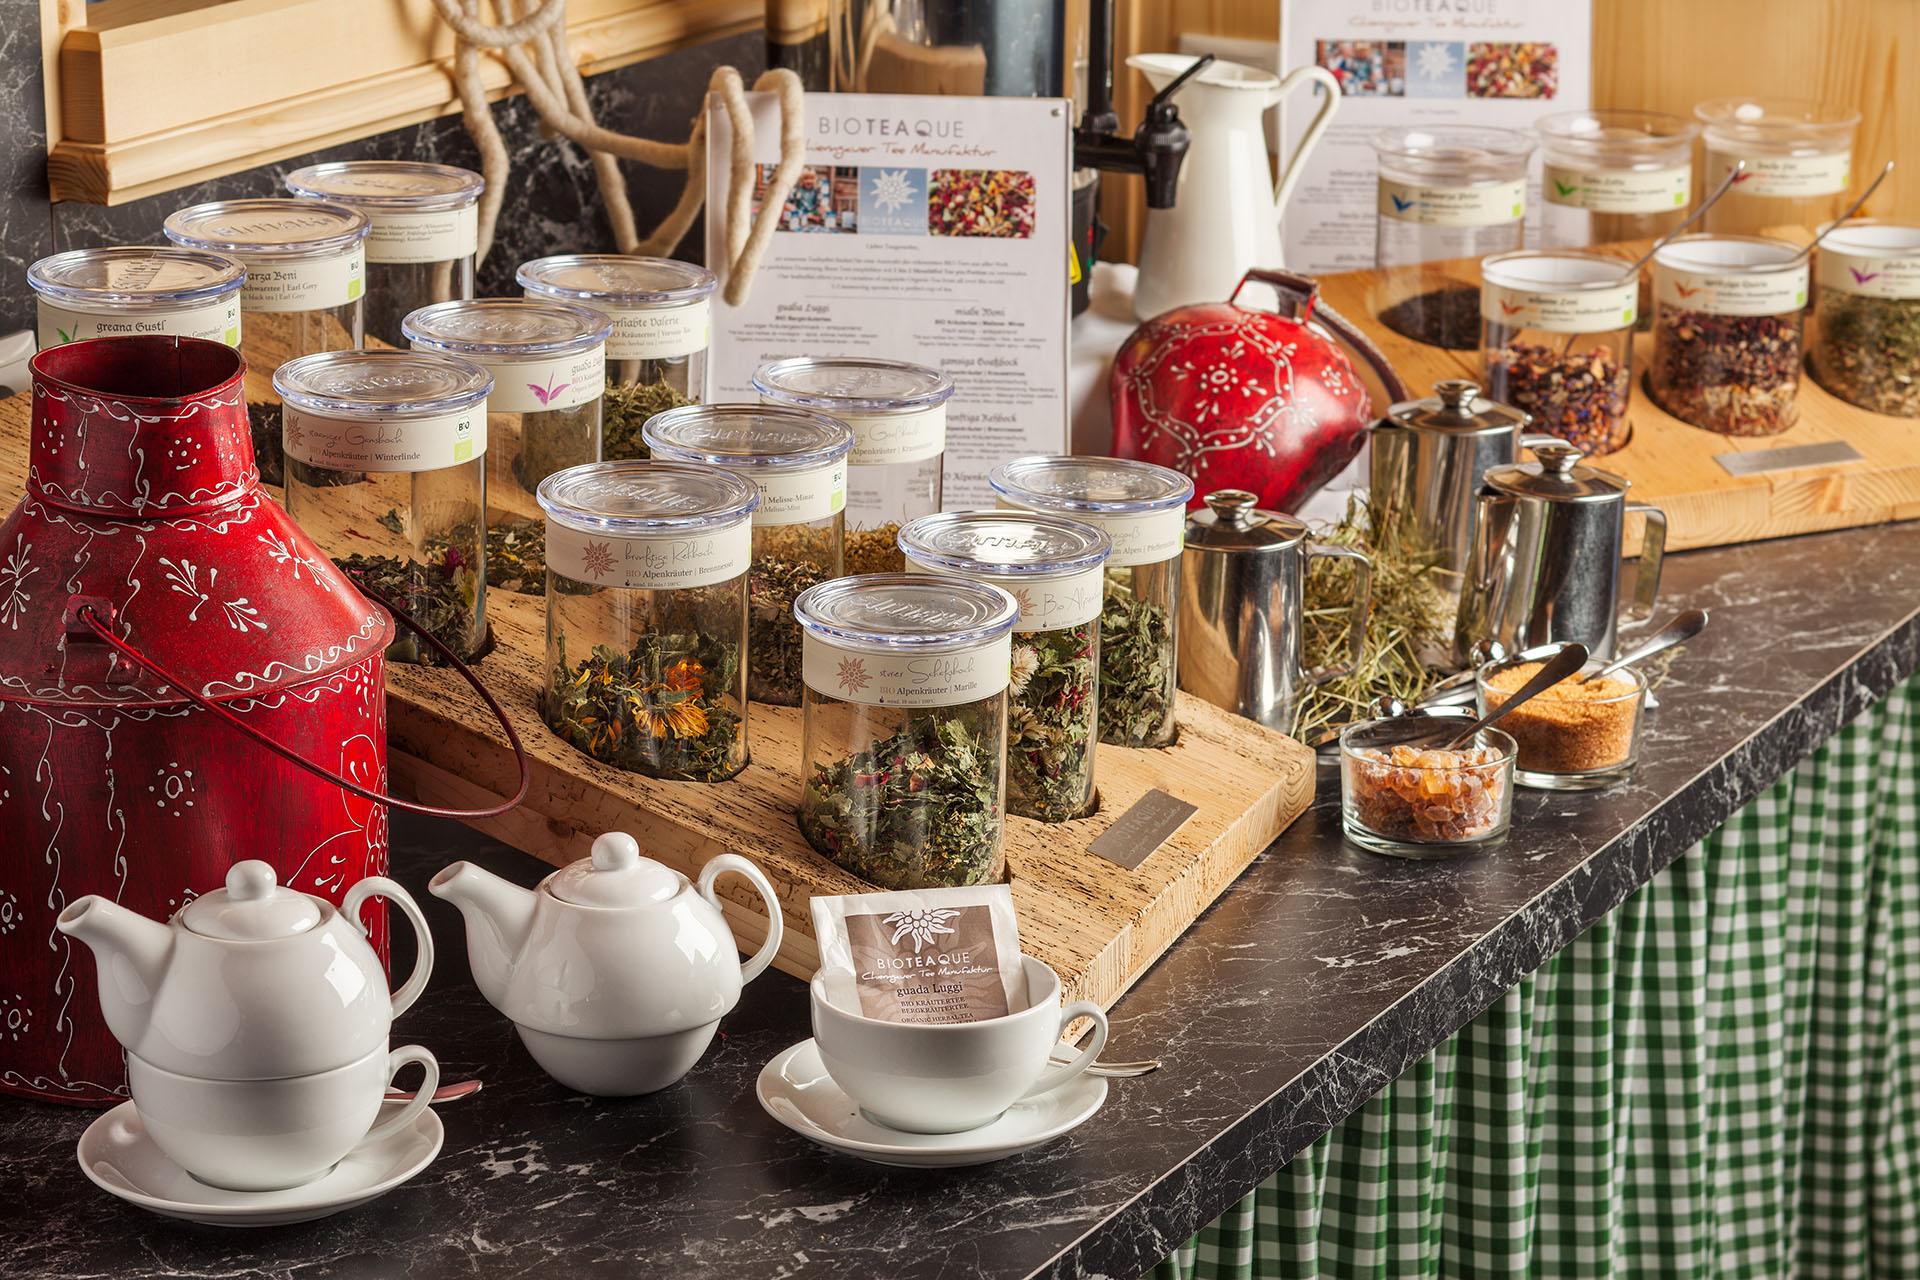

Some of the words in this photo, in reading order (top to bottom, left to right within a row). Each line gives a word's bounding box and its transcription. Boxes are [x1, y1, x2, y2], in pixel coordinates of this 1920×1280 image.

[819, 116, 964, 138] BIOTEAQUE
[882, 142, 905, 155] Tee
[910, 142, 998, 158] Manufaktur
[273, 269, 298, 281] Beni
[287, 283, 302, 292] Earl
[96, 322, 133, 334] greana
[135, 319, 167, 333] Gustl
[612, 317, 648, 328] erliabte
[321, 449, 369, 463] Alpenkräuter
[375, 452, 421, 461] Winterlinde
[852, 447, 896, 457] Alpenkräuter
[625, 569, 642, 578] BIO
[642, 569, 693, 580] Alpenkräuter
[879, 687, 895, 695] BIO
[896, 685, 948, 697] Alpenkräuter
[954, 681, 978, 692] Marille
[877, 952, 971, 970] BIOTEAQUE
[919, 969, 936, 978] Tee
[938, 965, 993, 976] Manufaktur
[896, 984, 930, 997] guada
[932, 981, 963, 994] Luggi
[901, 1015, 932, 1024] ORGANIC
[932, 1014, 960, 1022] HERBAL
[960, 1012, 975, 1020] TEA
